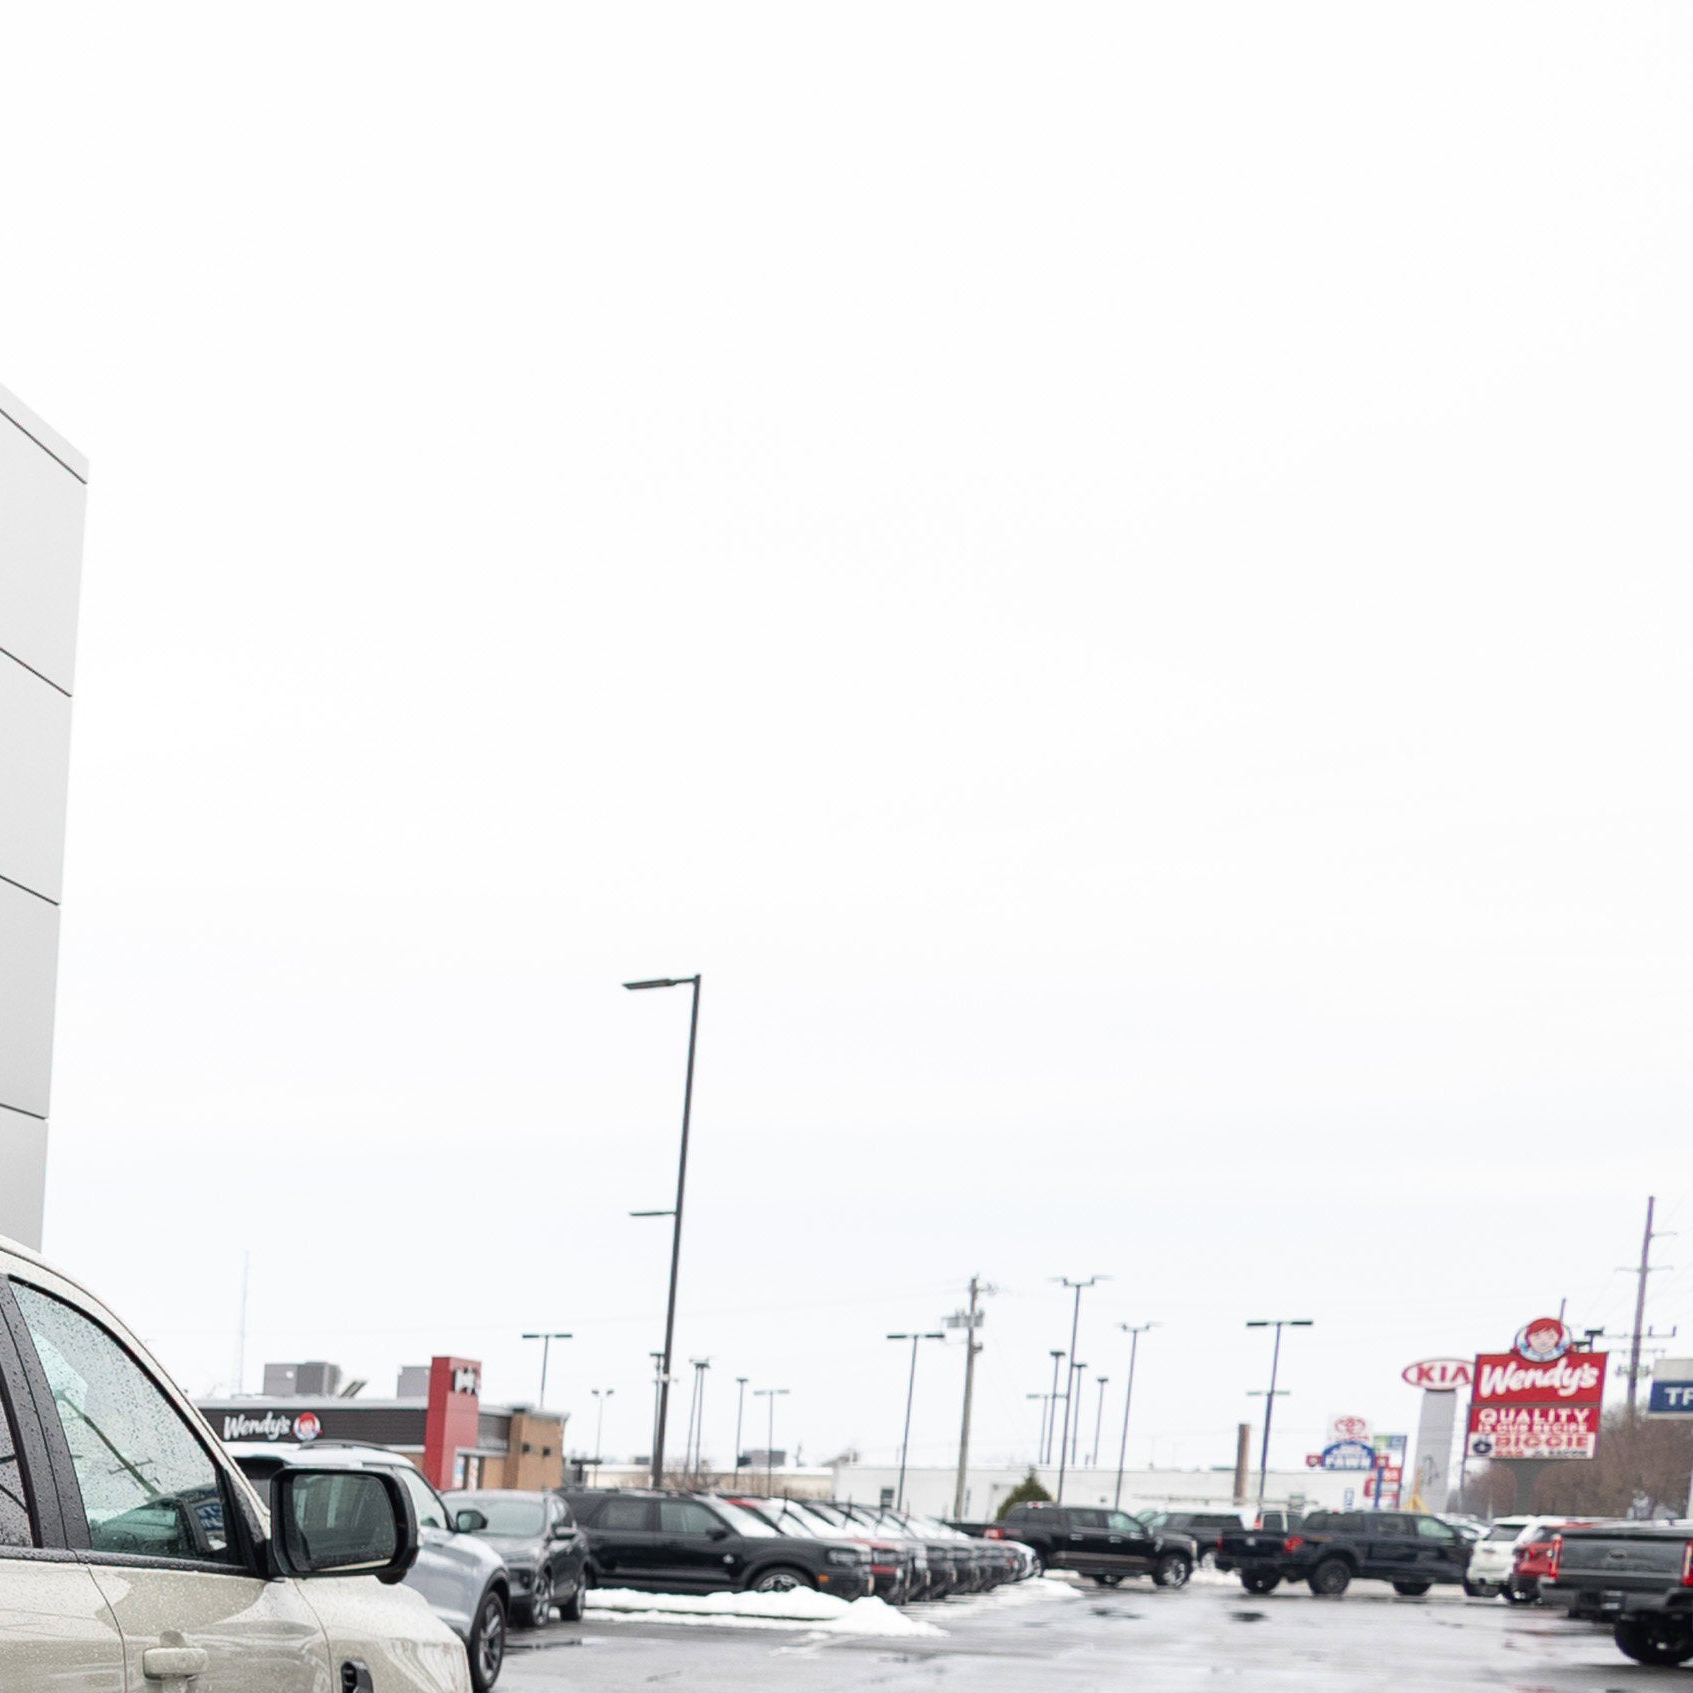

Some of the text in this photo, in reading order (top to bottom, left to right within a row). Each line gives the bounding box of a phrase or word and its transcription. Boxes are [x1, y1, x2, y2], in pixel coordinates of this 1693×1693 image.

[1417, 1364, 1471, 1384] KIA
[1479, 1357, 1600, 1398] Wendy's
[223, 1411, 291, 1440] Wendy's
[1478, 1408, 1590, 1425] QUALITY
